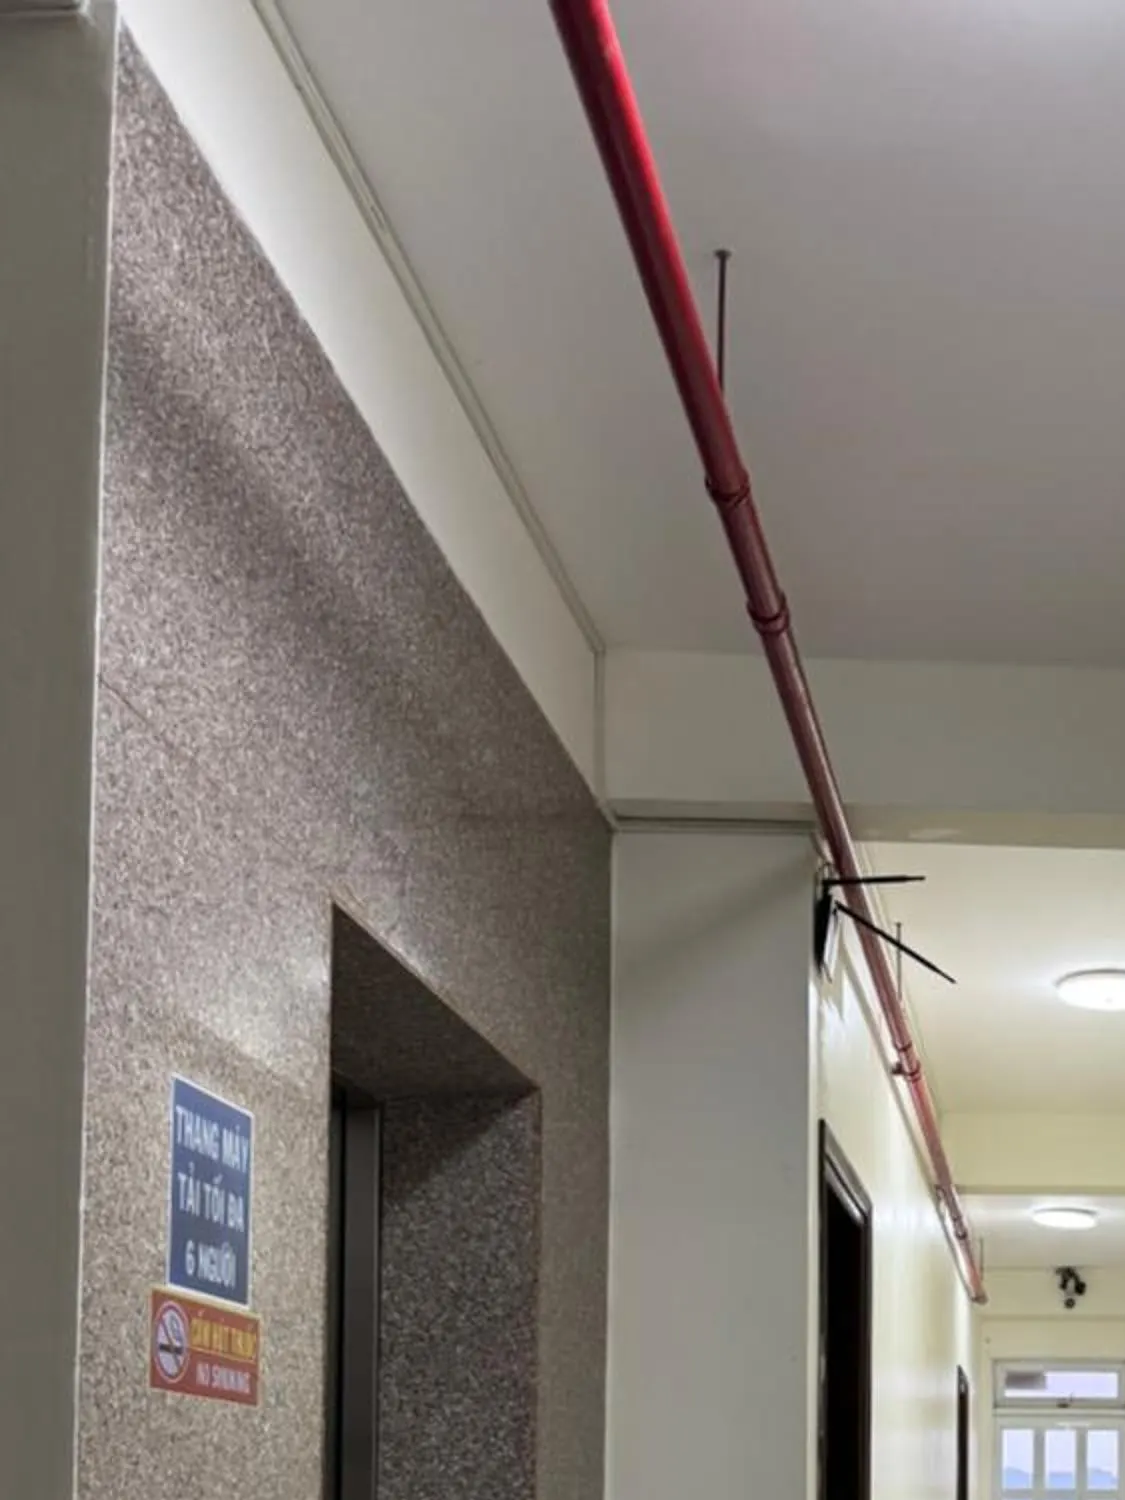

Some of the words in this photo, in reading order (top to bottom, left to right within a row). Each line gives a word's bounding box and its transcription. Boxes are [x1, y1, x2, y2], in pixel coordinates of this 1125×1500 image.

[175, 1104, 219, 1160] THANG
[222, 1124, 249, 1173] MÁY
[177, 1160, 200, 1216] TẢI
[185, 1240, 195, 1277] 6
